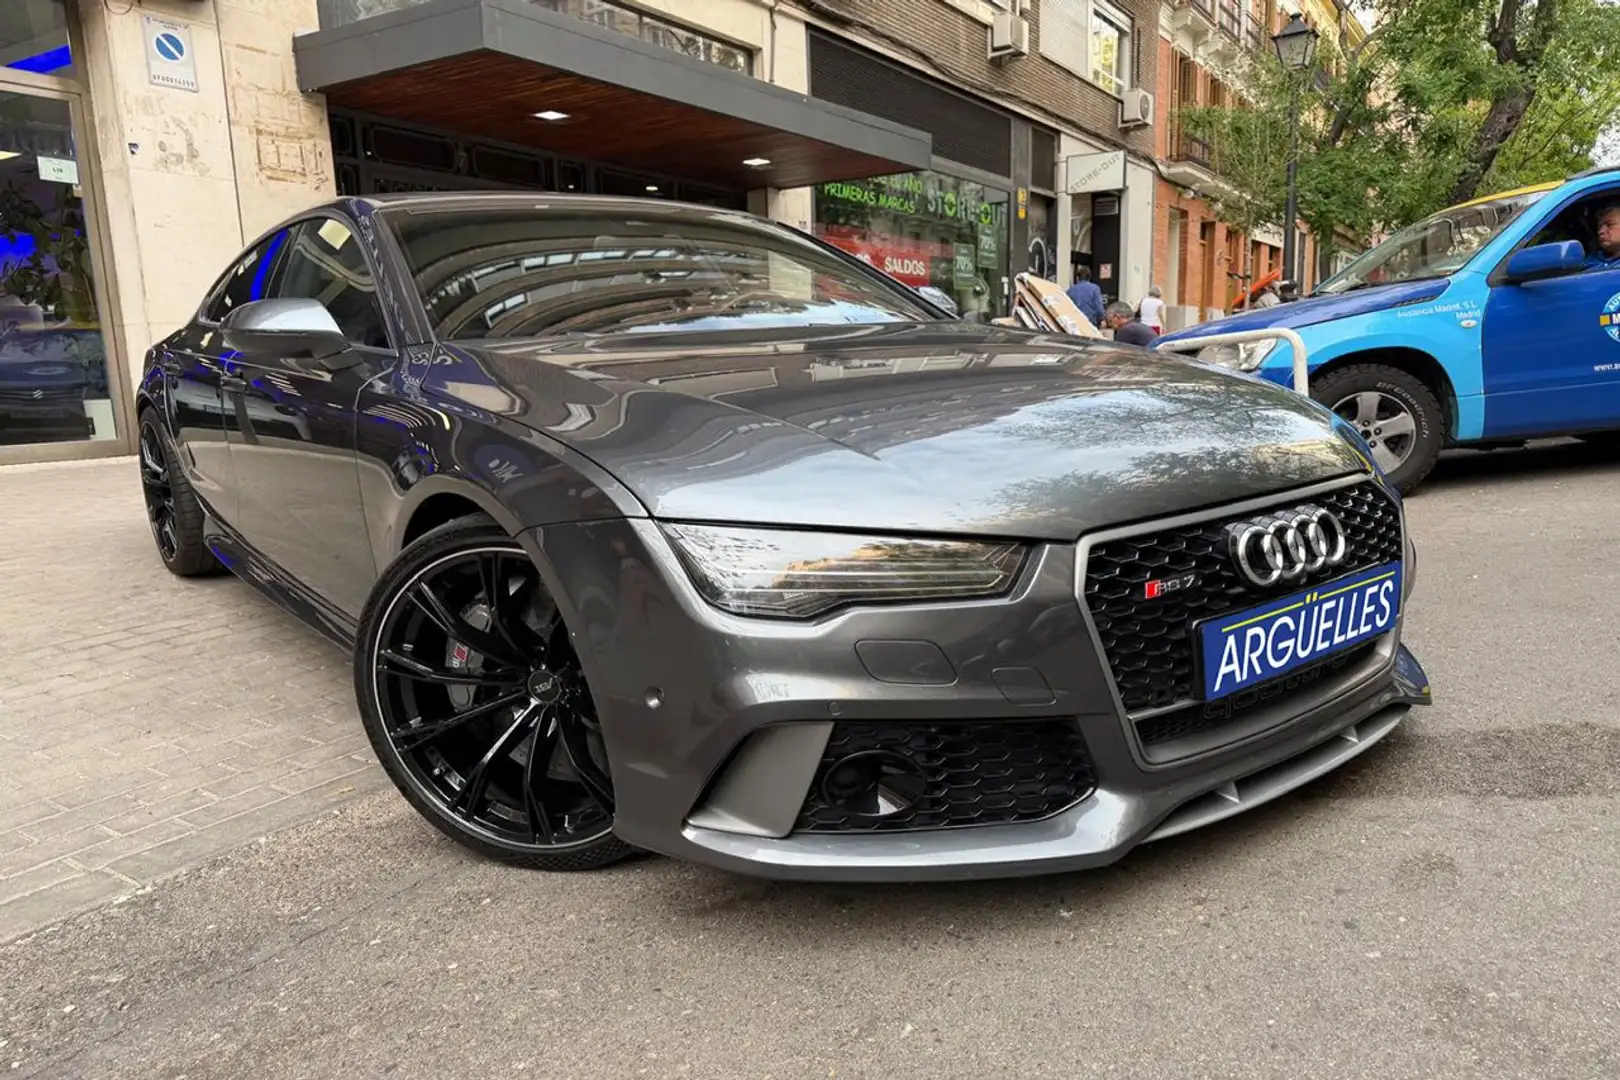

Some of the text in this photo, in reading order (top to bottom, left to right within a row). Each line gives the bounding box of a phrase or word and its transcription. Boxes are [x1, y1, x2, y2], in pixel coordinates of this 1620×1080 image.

[1070, 153, 1120, 192] STORE-OUT
[824, 183, 916, 215] PRIMERAS MARCAS
[928, 188, 1008, 229] STORE-OUT
[884, 256, 926, 276] SALDOS
[956, 255, 973, 272] 70%
[1213, 579, 1394, 693] ARGÜELLES
